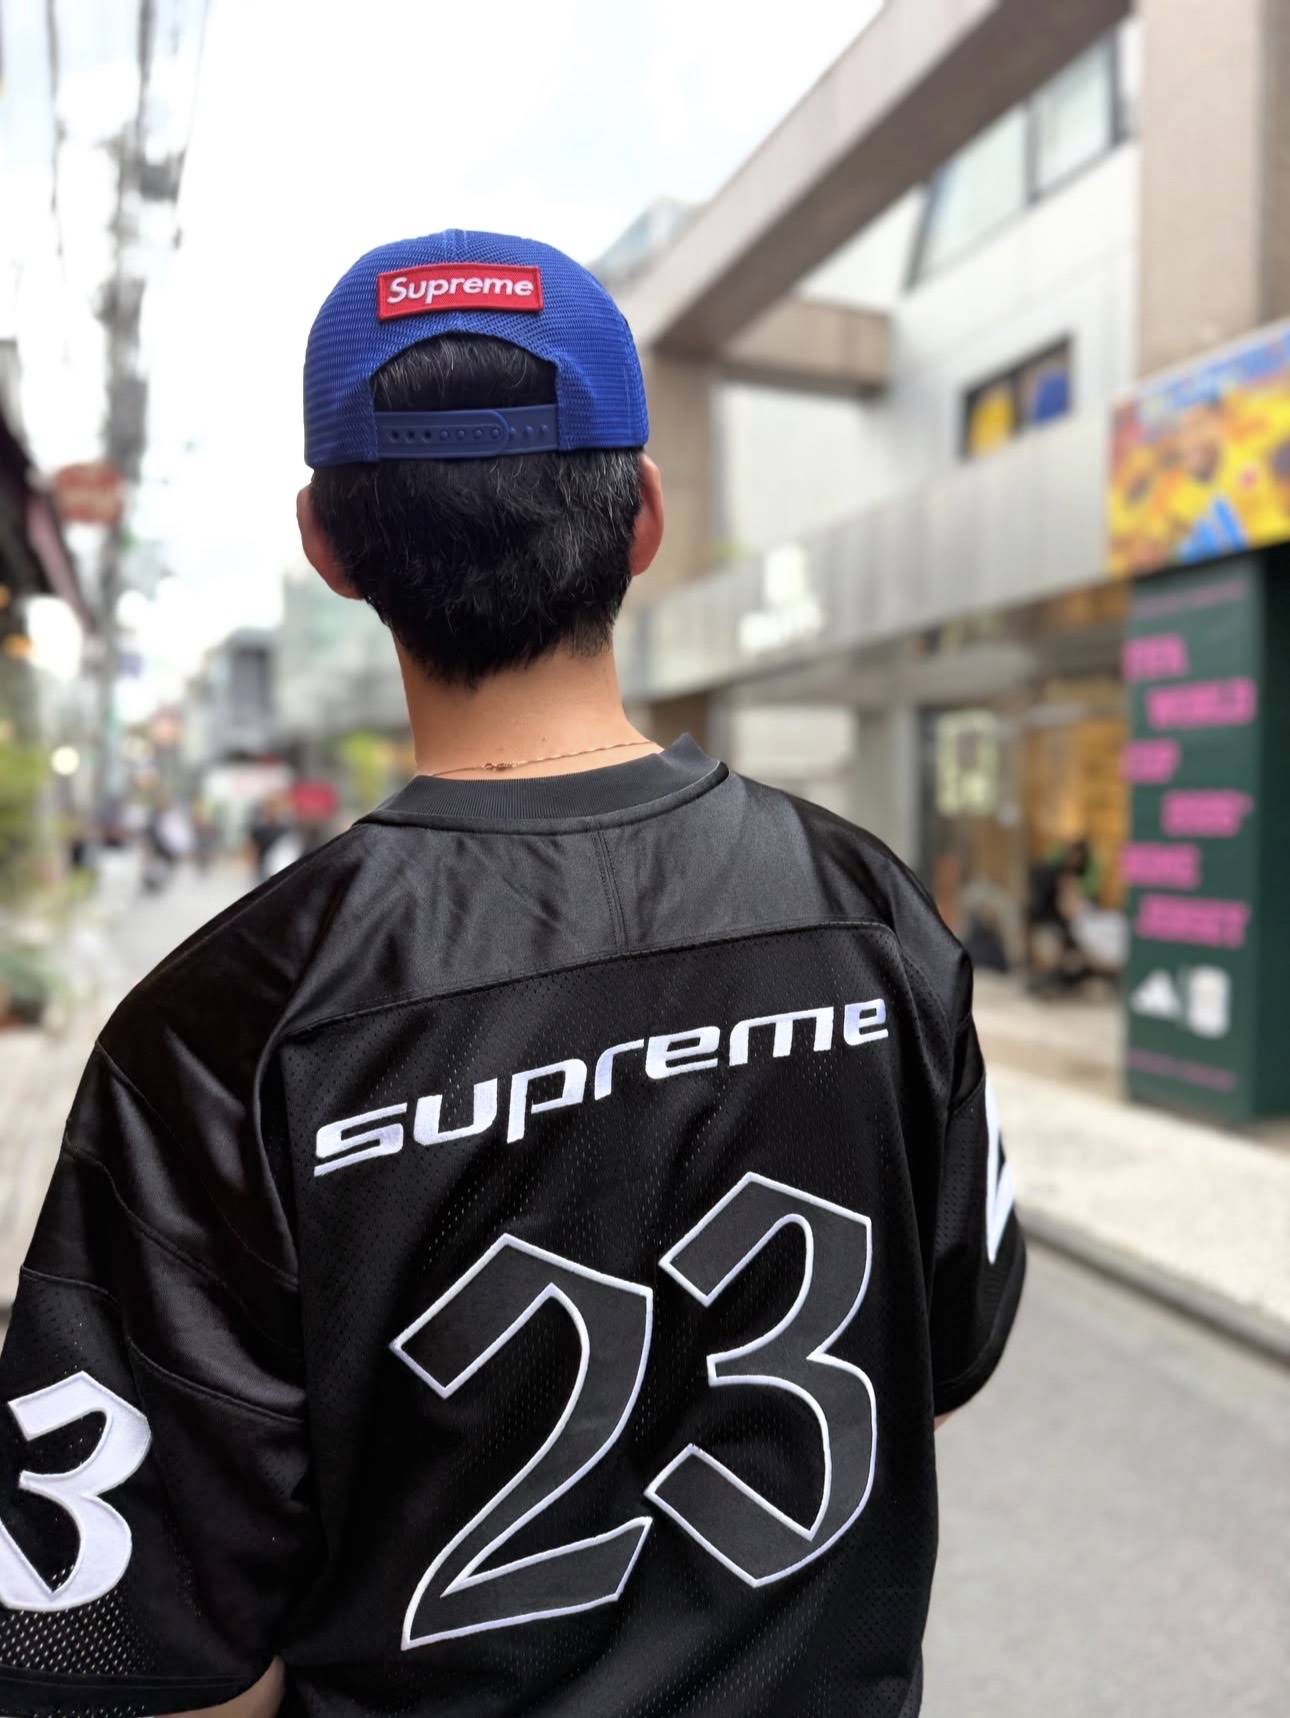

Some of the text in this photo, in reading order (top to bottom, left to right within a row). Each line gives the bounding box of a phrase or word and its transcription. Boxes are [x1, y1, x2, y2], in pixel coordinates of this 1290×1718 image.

[387, 277, 534, 305] Supreme
[314, 998, 889, 1177] supreme
[0, 1370, 152, 1612] 3
[389, 1171, 878, 1652] 23
